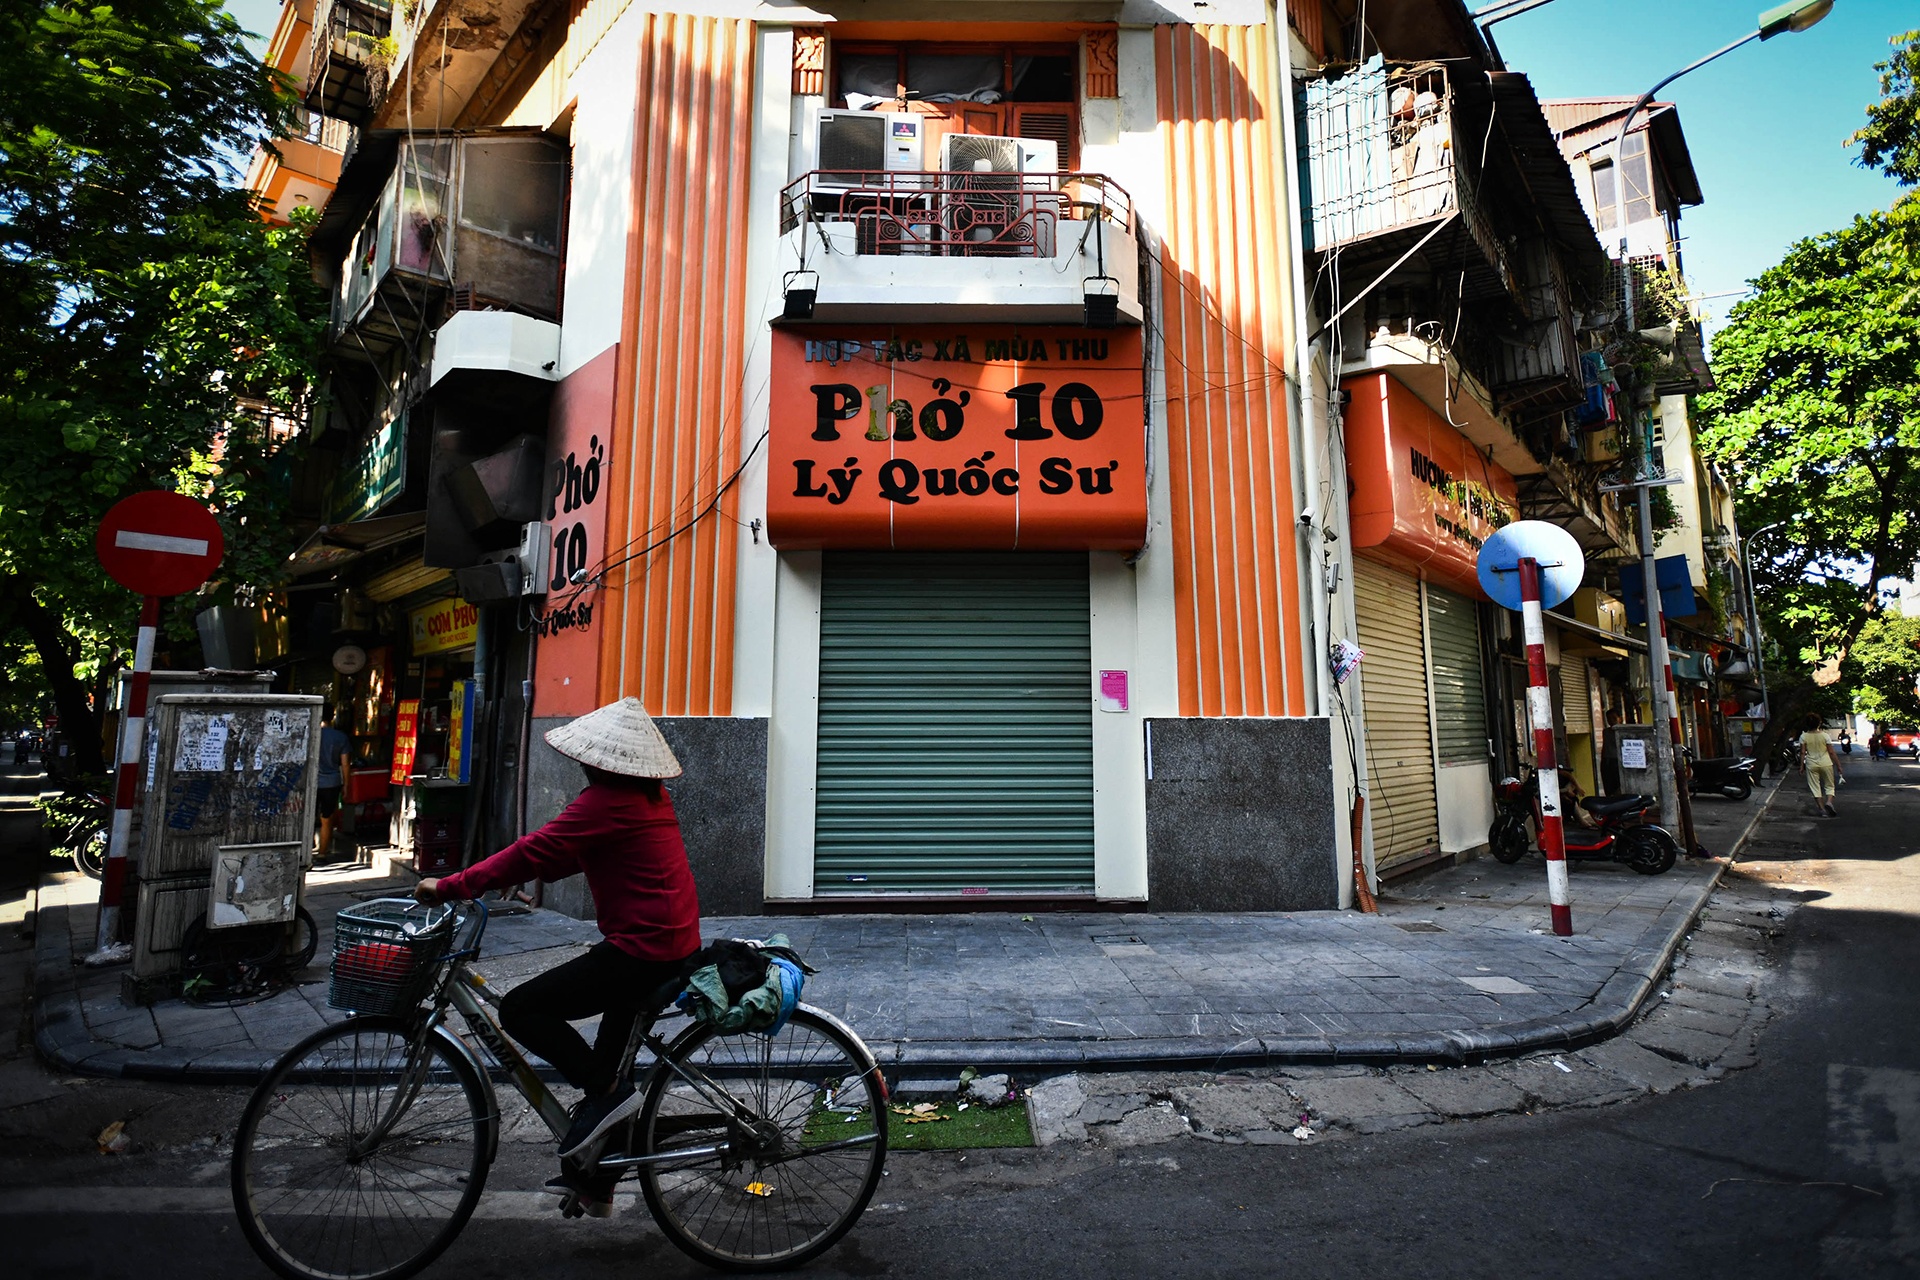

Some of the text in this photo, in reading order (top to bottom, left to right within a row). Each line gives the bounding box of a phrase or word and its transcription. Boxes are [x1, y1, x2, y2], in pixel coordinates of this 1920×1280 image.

[804, 335, 1109, 367] HỢP TÁC XÃ MÙA THU
[809, 377, 1104, 442] Phở 10
[546, 434, 603, 521] Phở
[791, 450, 1119, 505] Lý Quốc Sư
[550, 521, 588, 591] 10
[464, 1013, 517, 1073] ASAMA
